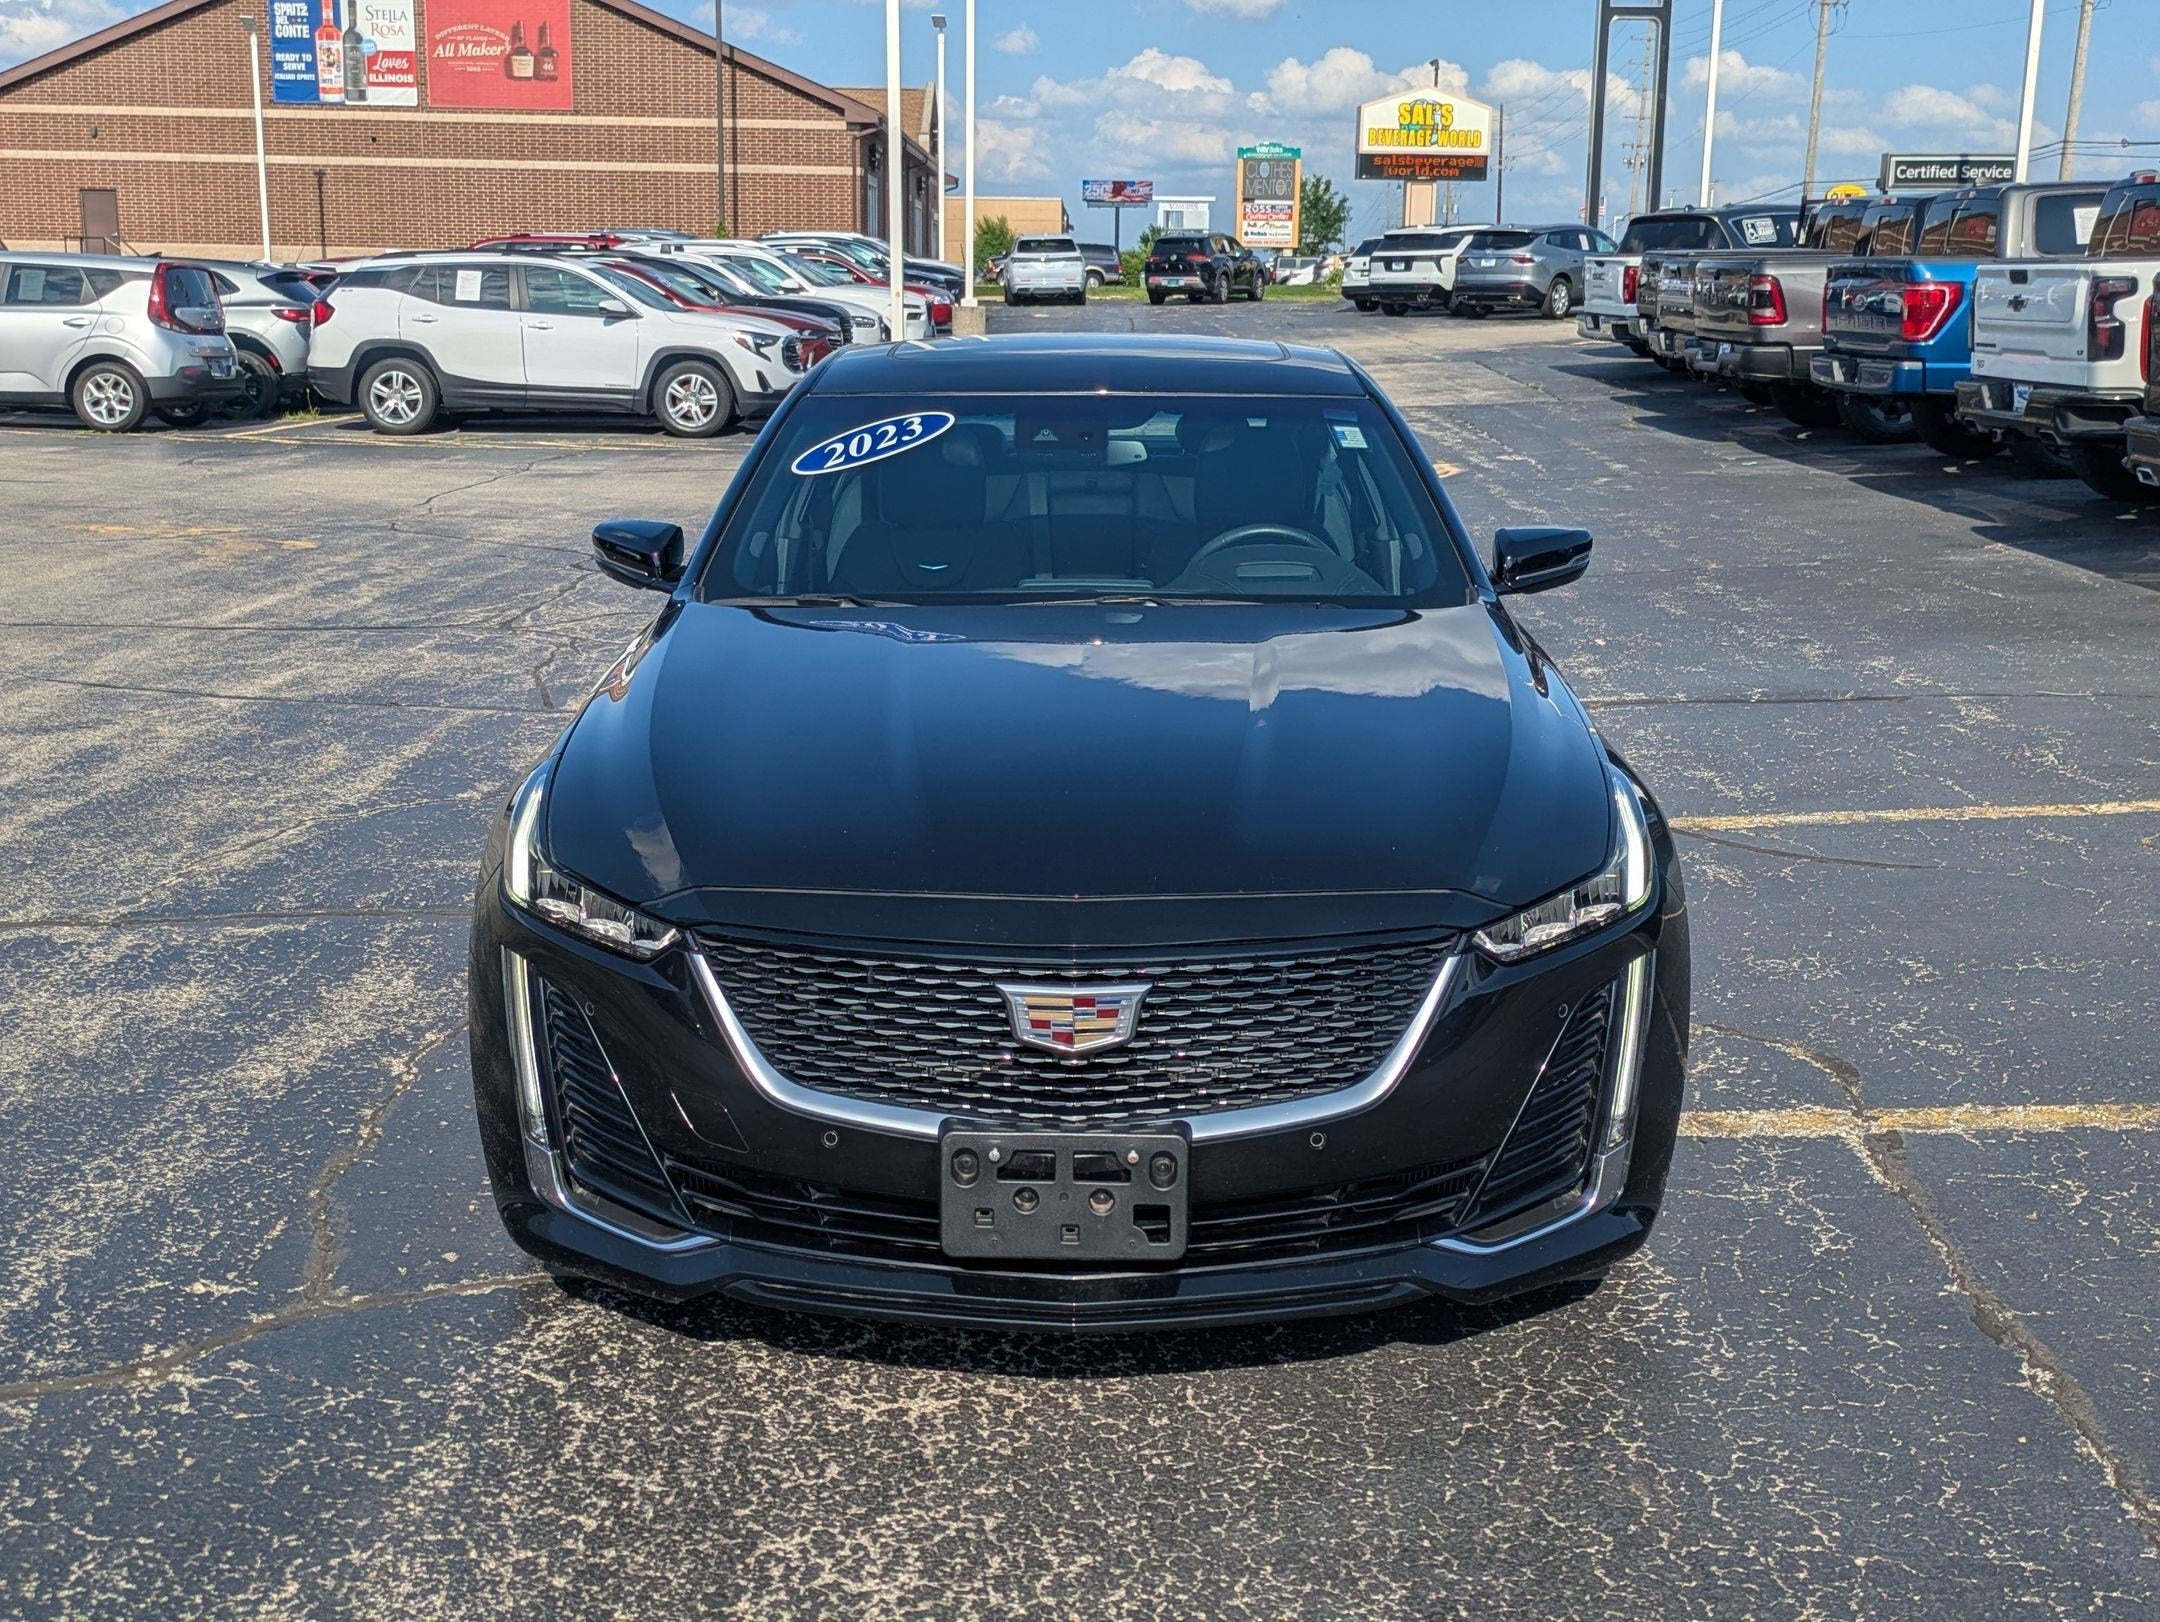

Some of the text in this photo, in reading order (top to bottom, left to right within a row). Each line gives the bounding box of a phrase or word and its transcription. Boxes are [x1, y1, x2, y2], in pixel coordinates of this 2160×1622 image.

[274, 2, 309, 16] SPRITZ
[365, 5, 408, 23] STELLA
[275, 16, 289, 24] DEL
[275, 25, 310, 38] CONTE
[371, 22, 405, 38] ROSA
[434, 24, 510, 41] DIFFERENT LAYERS
[432, 39, 512, 57] All Maker's
[275, 53, 312, 61] READY TO
[372, 51, 409, 72] Loves
[283, 62, 306, 71] SERVE
[542, 62, 554, 71] 46
[369, 73, 414, 83] ILLINOIS
[1398, 102, 1454, 126] SAL'S
[1367, 127, 1482, 148] BEVERAGE WORLD
[1373, 154, 1475, 168] salsbeverage
[1246, 160, 1293, 179] CLOTHES
[1388, 165, 1459, 176] world.com
[1896, 164, 2012, 179] Certified Service
[1245, 179, 1293, 196] MENTOR
[1245, 205, 1272, 213] ROSS
[823, 416, 924, 469] 2023
